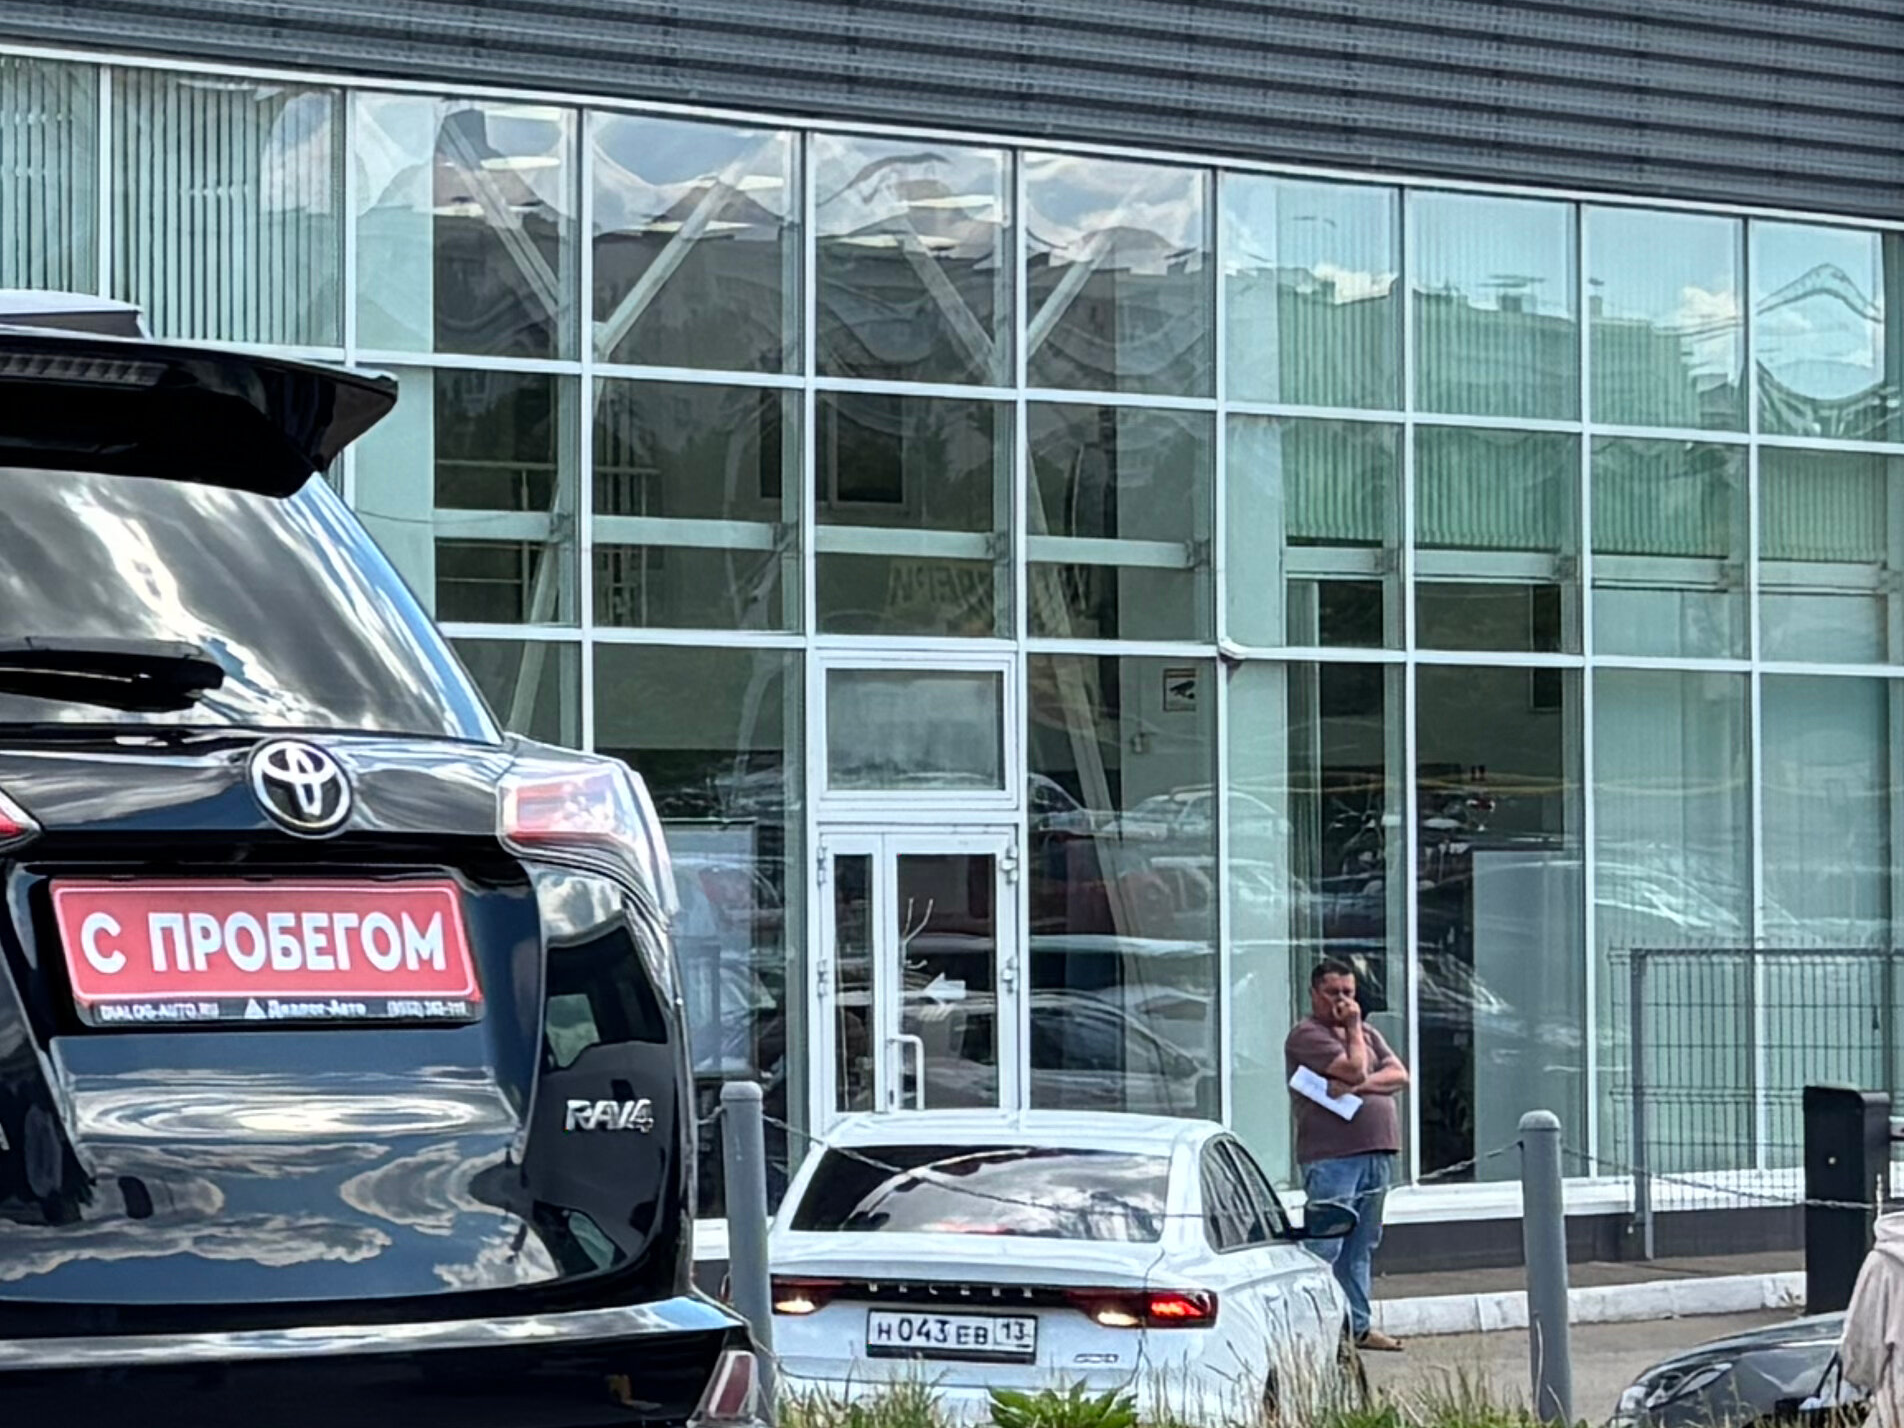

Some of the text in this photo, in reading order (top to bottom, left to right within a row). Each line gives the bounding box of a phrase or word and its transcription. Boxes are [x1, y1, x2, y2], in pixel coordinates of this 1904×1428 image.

[81, 911, 446, 973] С ПРОБЕГОМ
[564, 1098, 655, 1133] RAV4
